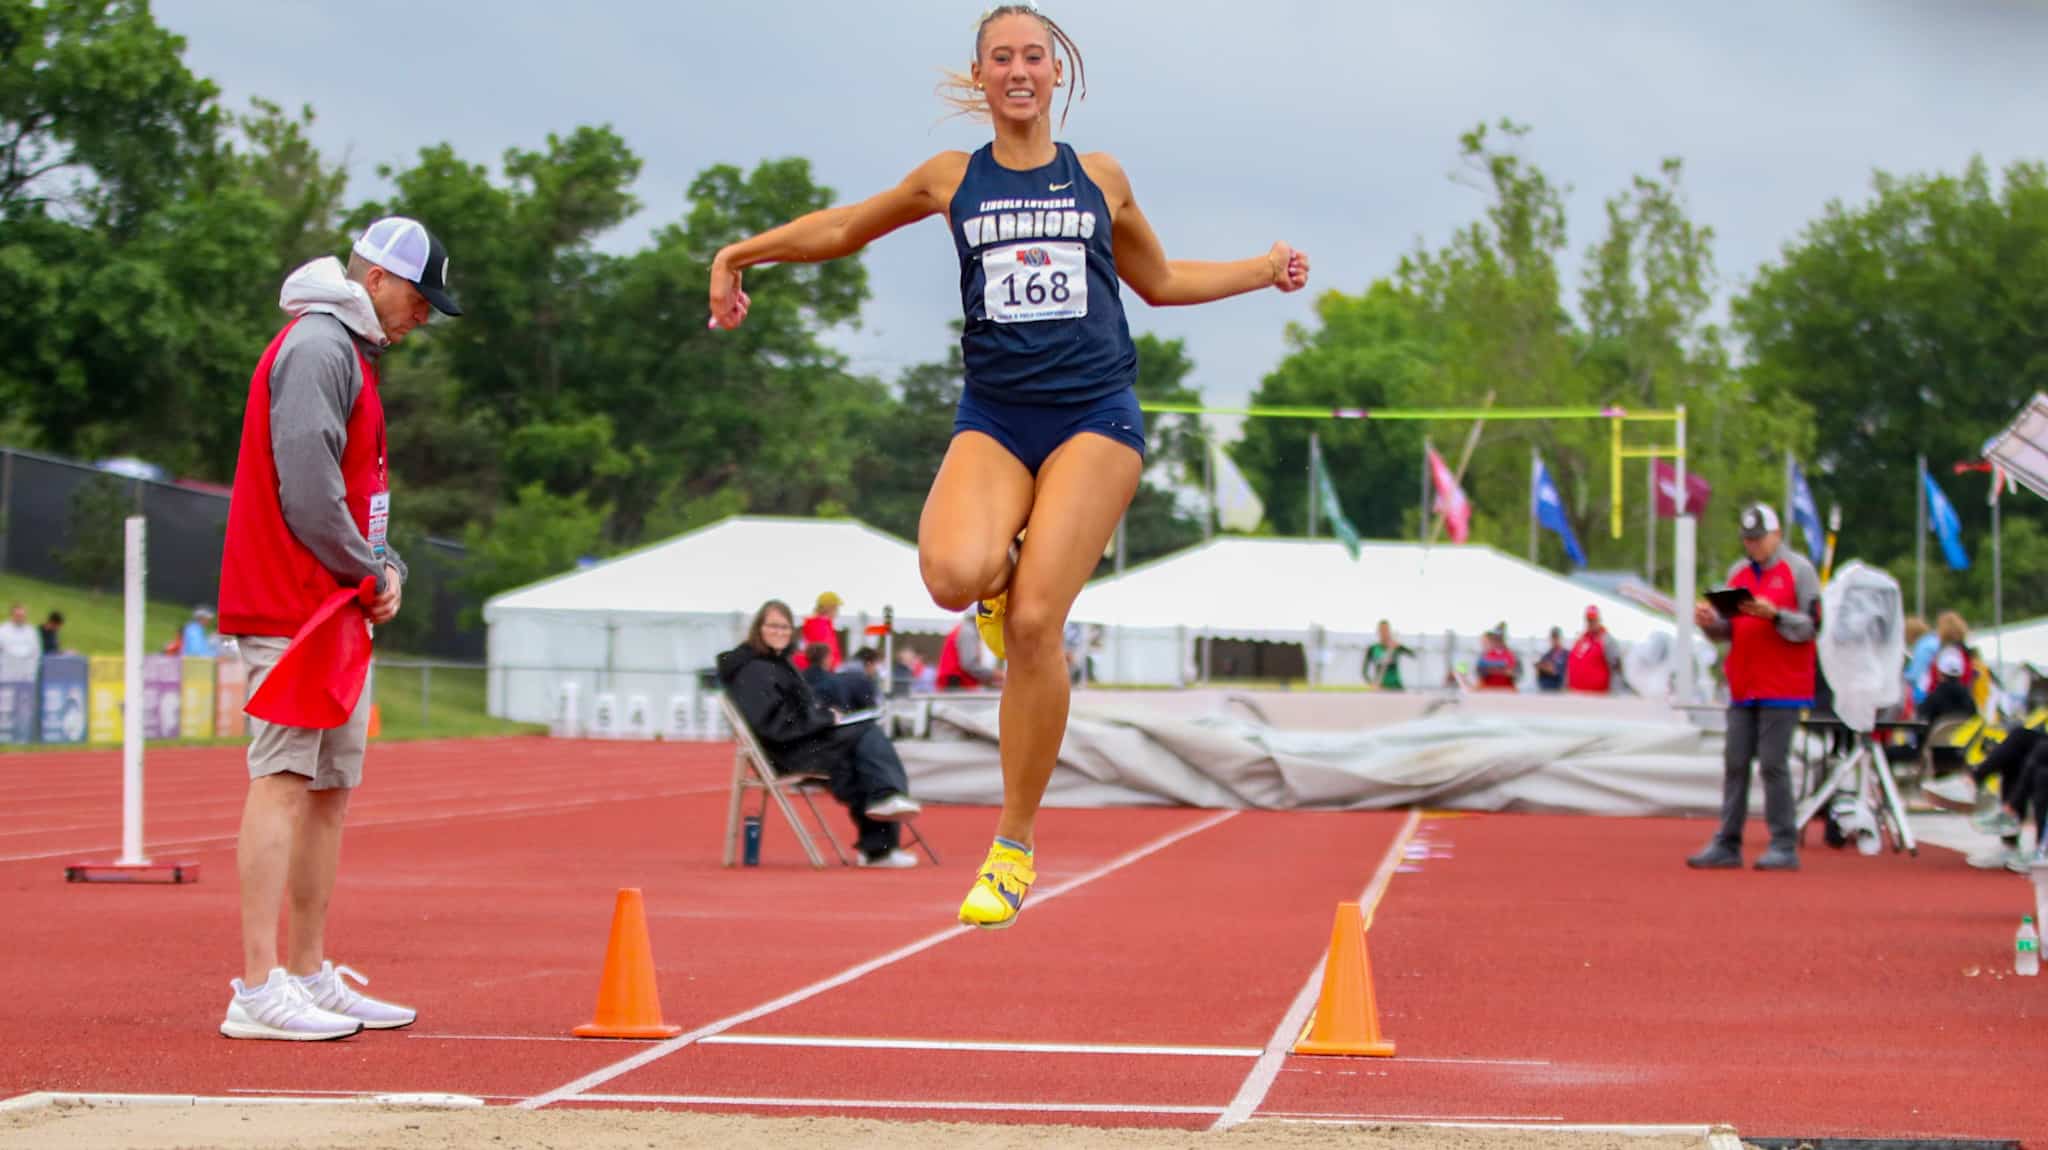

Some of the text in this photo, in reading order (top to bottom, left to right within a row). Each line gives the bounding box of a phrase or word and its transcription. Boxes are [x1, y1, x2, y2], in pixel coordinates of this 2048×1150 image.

[980, 198, 1075, 212] LINCOLN LUTHERAN
[963, 211, 1096, 247] WARRIORS
[1002, 271, 1070, 306] 168
